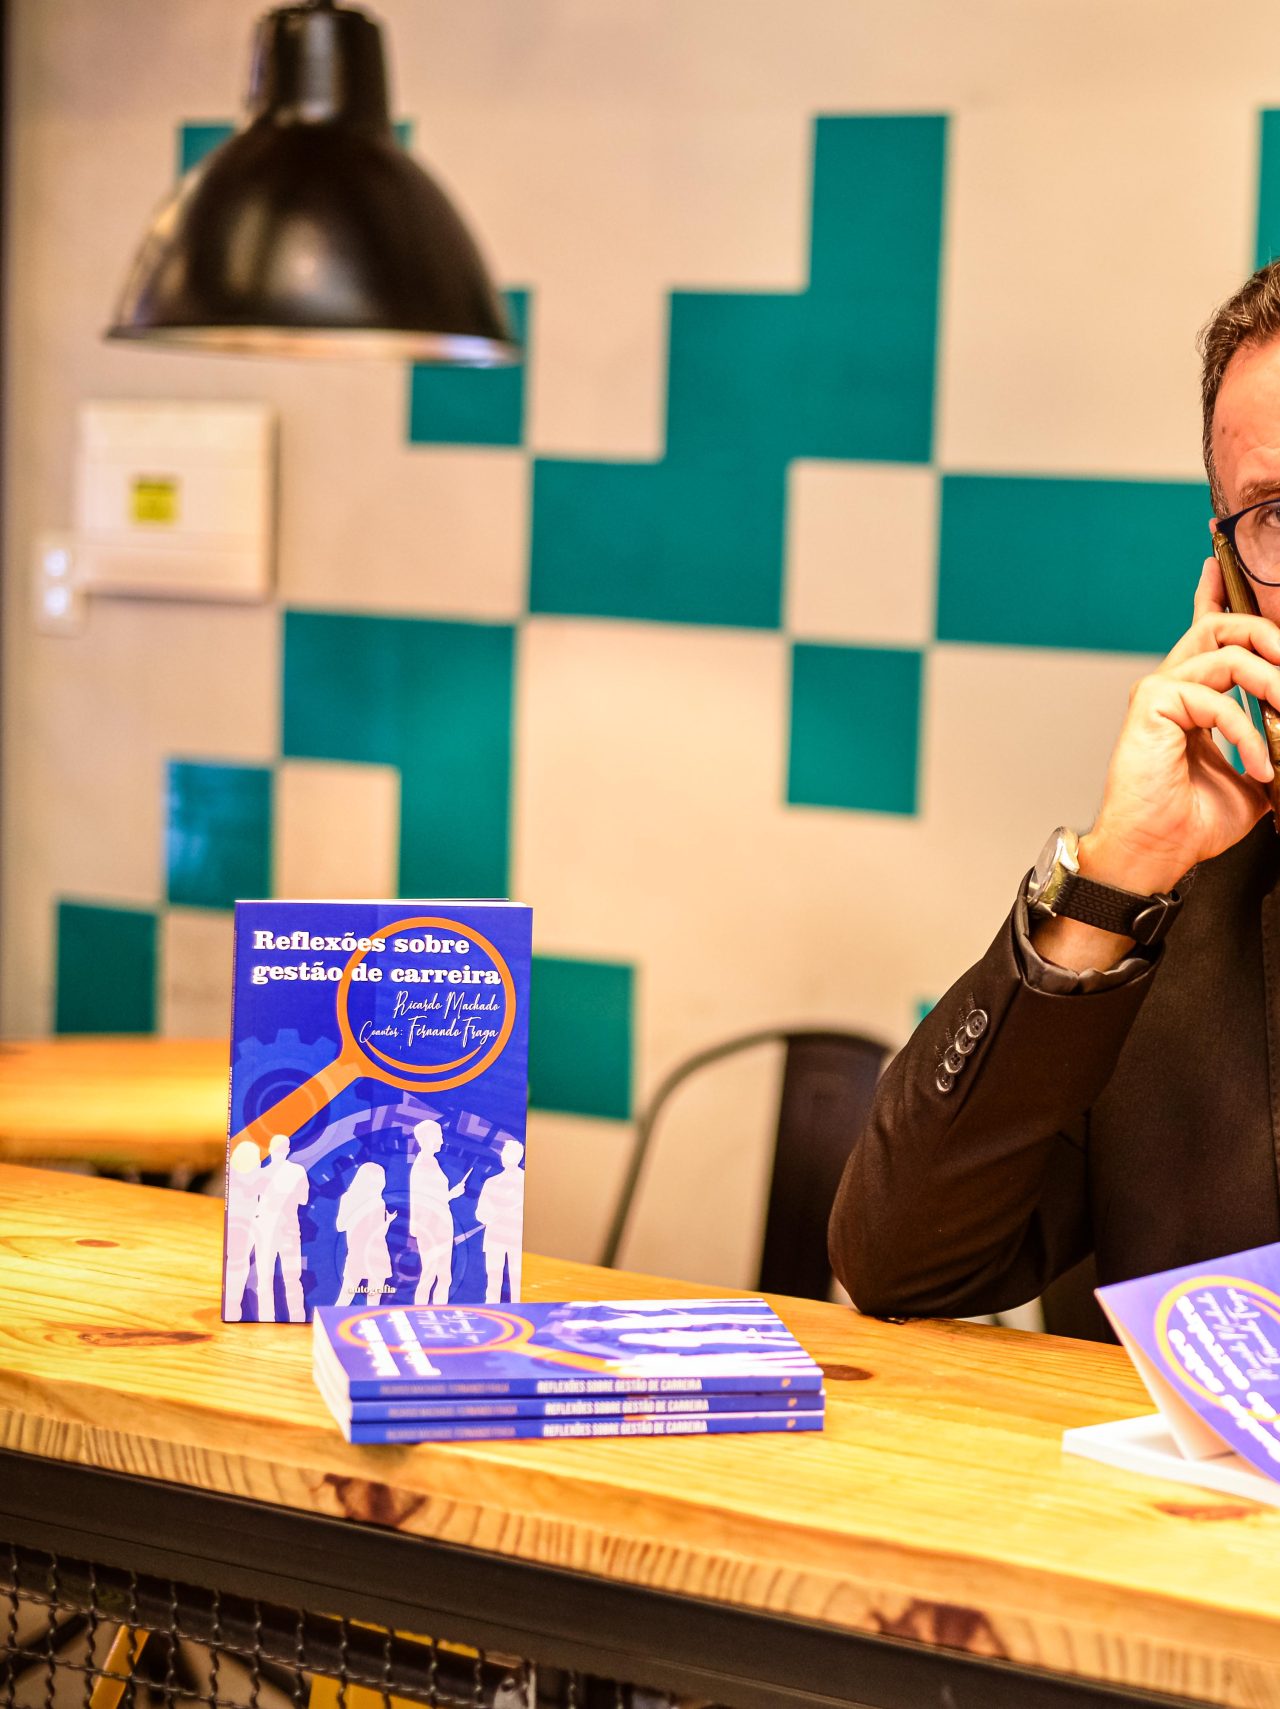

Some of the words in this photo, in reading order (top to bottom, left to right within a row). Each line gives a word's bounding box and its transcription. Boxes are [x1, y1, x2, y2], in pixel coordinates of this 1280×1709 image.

[253, 931, 386, 953] Reflexões
[394, 935, 470, 954] sobre
[252, 962, 343, 985] gestão
[351, 963, 383, 983] de
[391, 966, 501, 985] carreira
[393, 990, 442, 1019] Ricardo
[444, 991, 500, 1020] Machado
[408, 1015, 461, 1047] Fernando
[463, 1016, 499, 1048] Fraga
[348, 1284, 397, 1297] autografia
